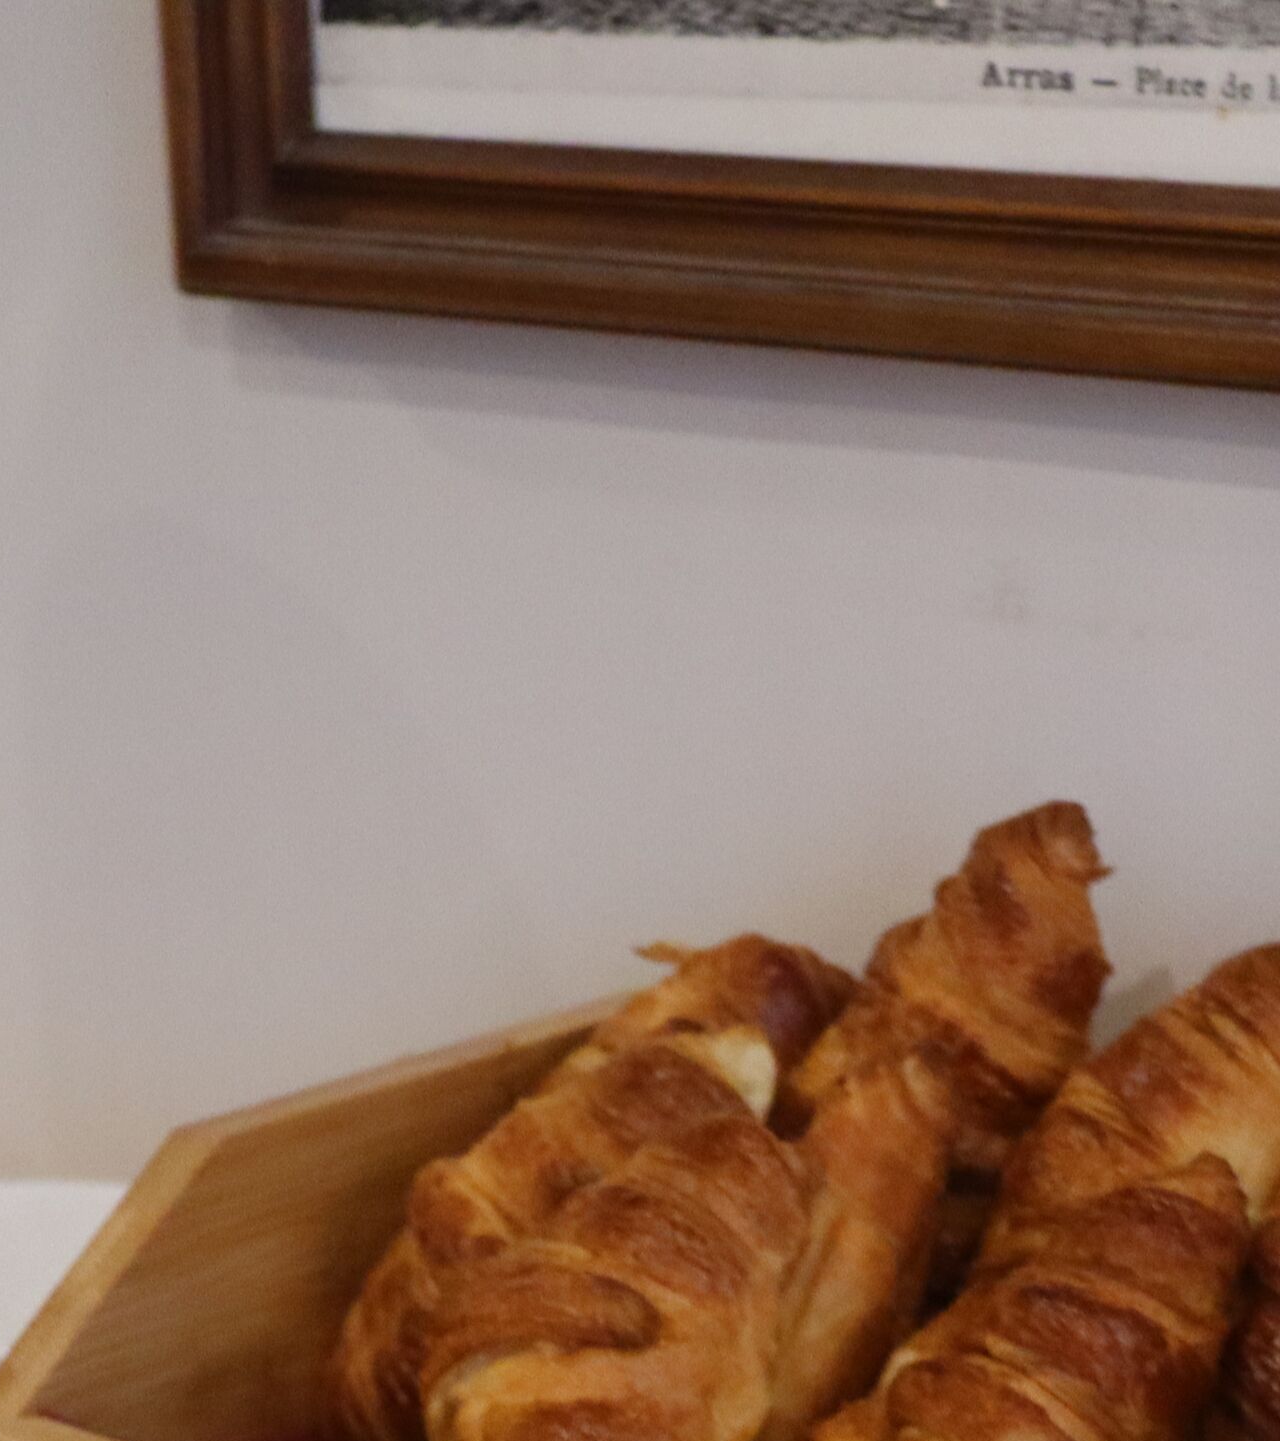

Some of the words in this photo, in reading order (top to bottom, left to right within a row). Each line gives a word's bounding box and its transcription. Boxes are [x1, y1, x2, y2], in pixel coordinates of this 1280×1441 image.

[982, 61, 1074, 92] Arras
[1135, 66, 1208, 98] Place
[1221, 72, 1253, 100] de
